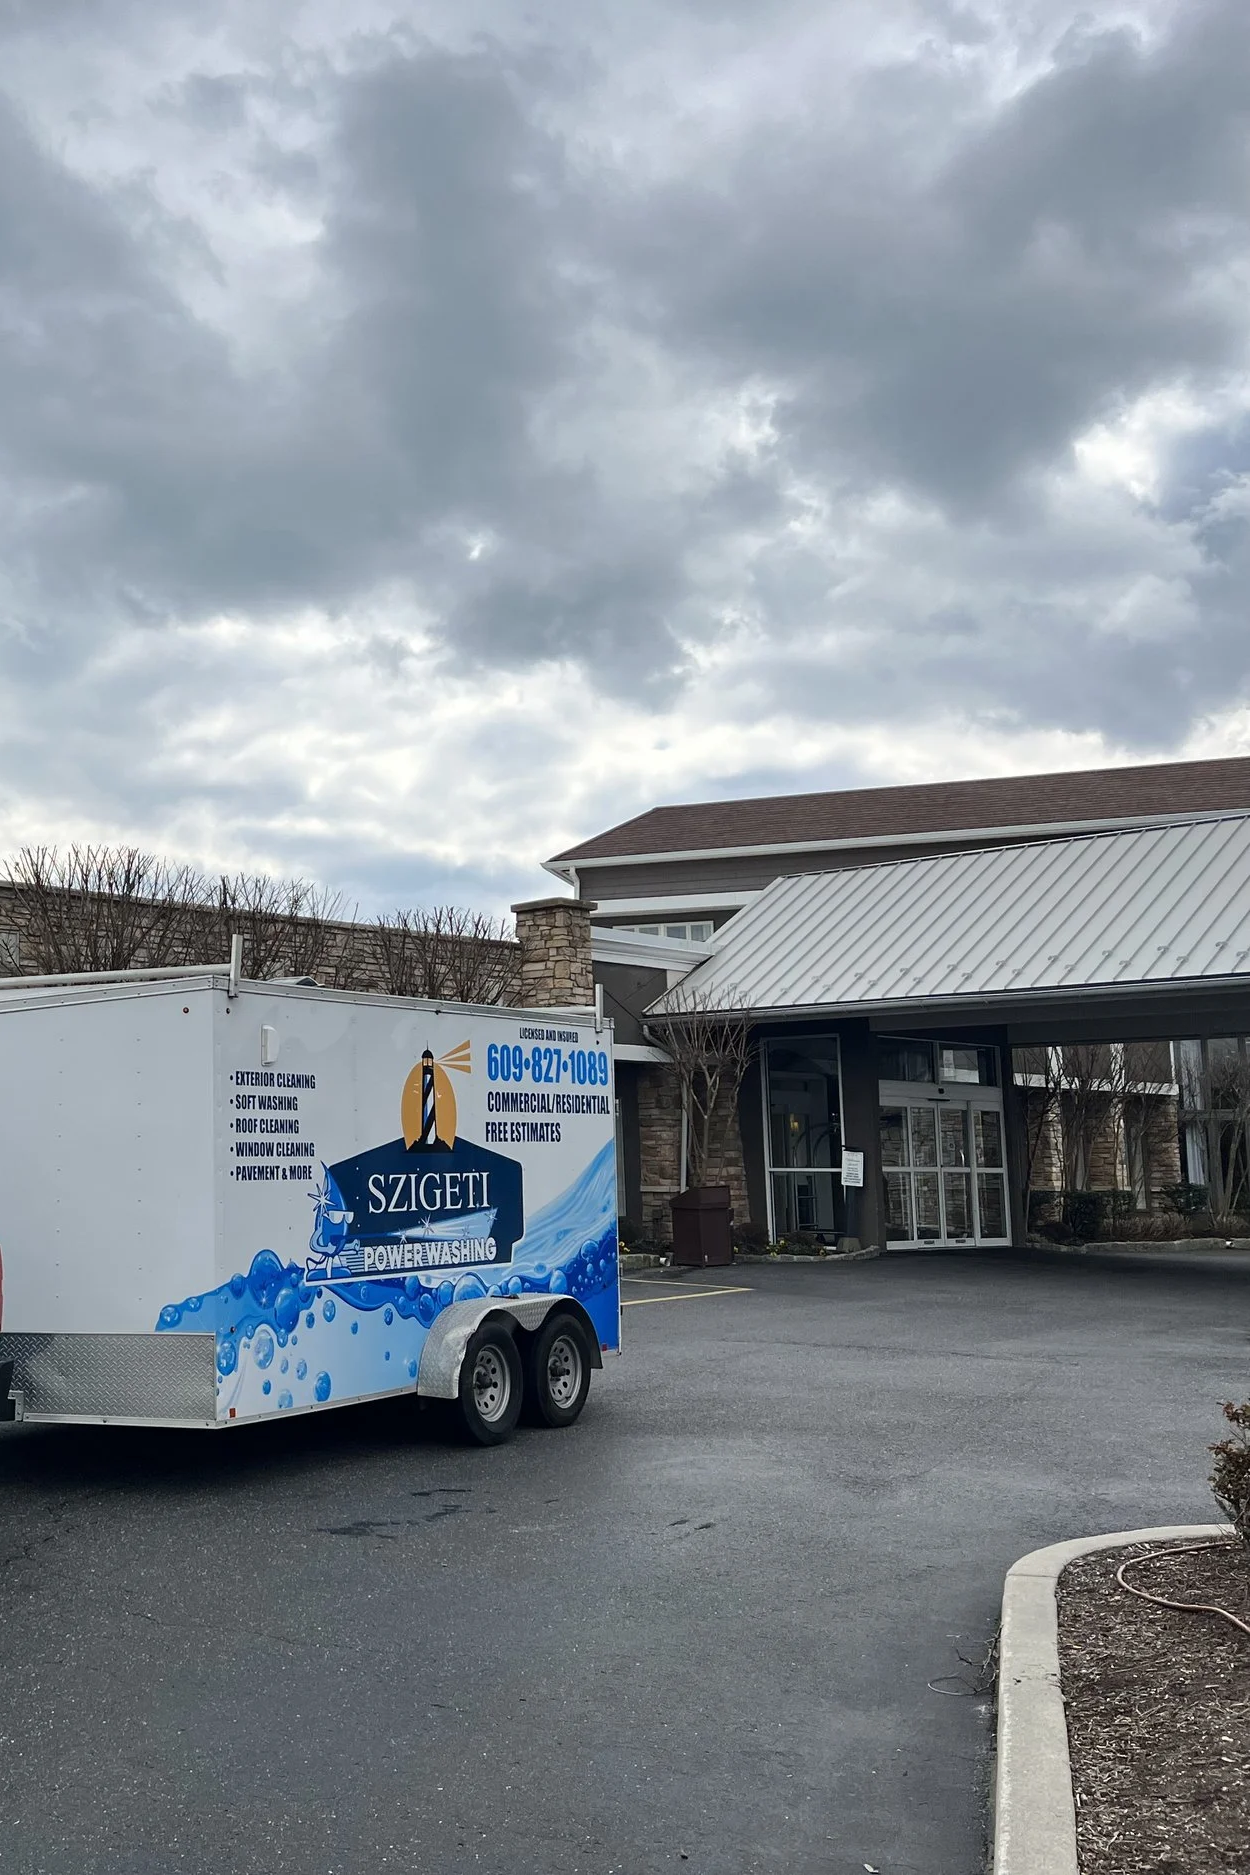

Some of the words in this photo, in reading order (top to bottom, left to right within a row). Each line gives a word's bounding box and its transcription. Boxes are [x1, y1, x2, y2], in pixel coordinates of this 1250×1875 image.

[519, 1027, 544, 1040] LICENSED
[546, 1030, 556, 1041] AND
[557, 1031, 578, 1043] INSURED
[235, 1071, 275, 1087] EXTERIOR
[276, 1073, 316, 1089] CLEANING
[235, 1094, 256, 1110] SOFT
[257, 1095, 298, 1111] WASHING
[487, 1091, 610, 1114] COMMERCIAL/RESIDENTIAL
[235, 1118, 258, 1133] ROOF
[259, 1118, 299, 1134] CLEANING
[485, 1121, 508, 1142] FREE
[510, 1122, 561, 1142] ESTIMATES
[235, 1142, 274, 1157] WINDOW
[276, 1142, 315, 1157] CLEANING
[235, 1165, 280, 1181] PAVEMENT
[282, 1167, 288, 1180] &
[289, 1165, 312, 1180] MORE
[368, 1171, 491, 1214] SZIGETI
[363, 1241, 423, 1272] POWER
[425, 1237, 497, 1266] WASHING
